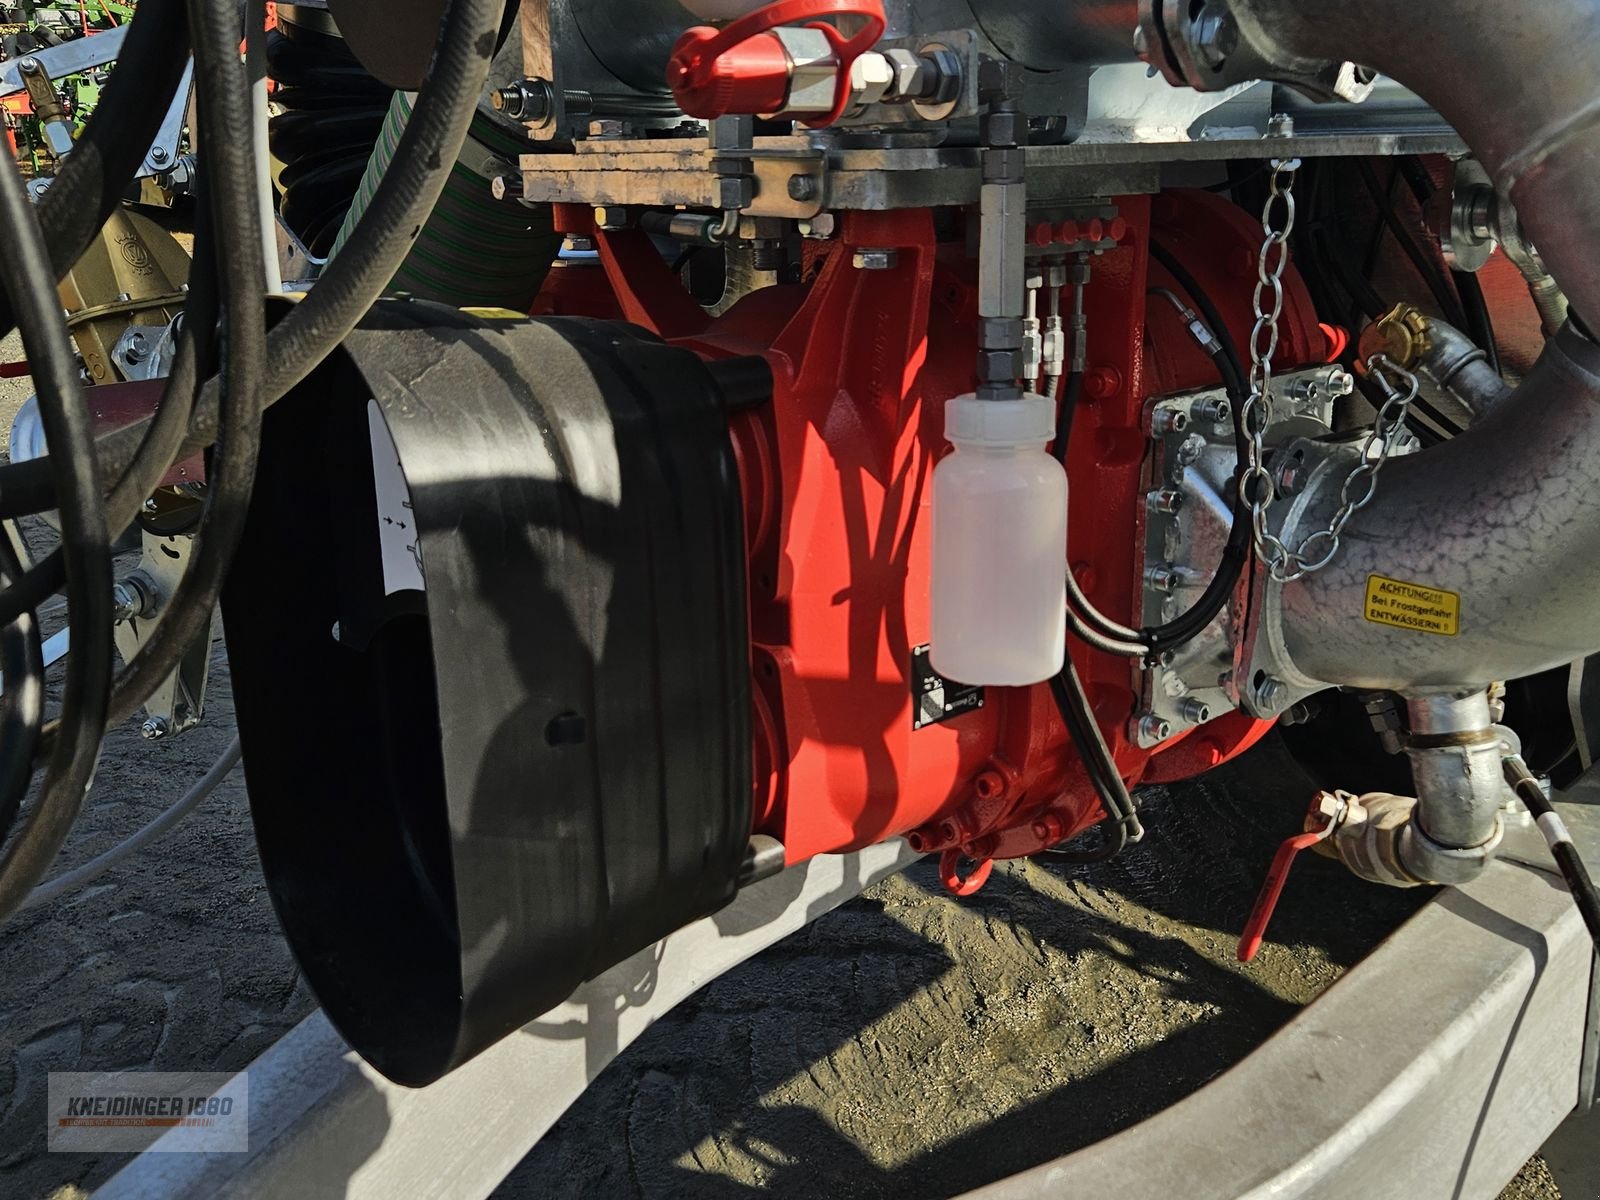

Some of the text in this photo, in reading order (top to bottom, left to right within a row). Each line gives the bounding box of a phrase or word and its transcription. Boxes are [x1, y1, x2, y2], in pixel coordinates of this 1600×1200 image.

[1371, 594, 1452, 619] Bei Frostgefahr
[1370, 608, 1440, 630] ENTWÄSSERN
